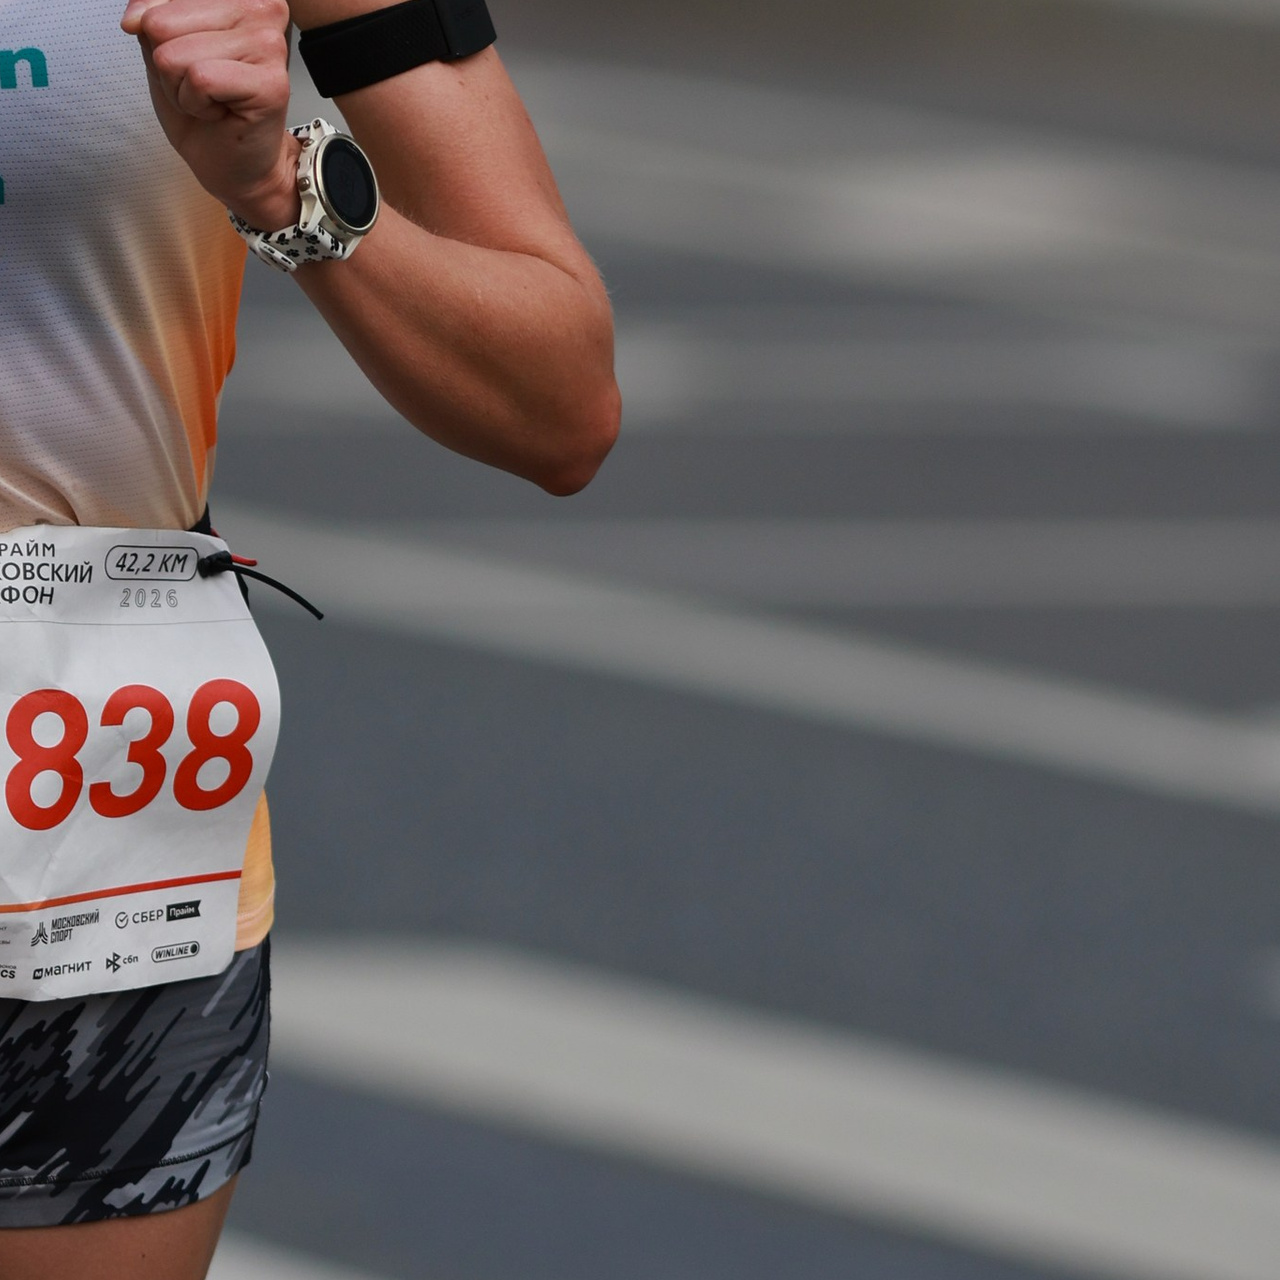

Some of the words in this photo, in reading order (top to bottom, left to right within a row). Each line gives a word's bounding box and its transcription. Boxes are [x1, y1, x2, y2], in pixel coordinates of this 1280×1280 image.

[115, 552, 156, 575] 42,2
[119, 587, 179, 608] 2026
[51, 908, 100, 930] МОСКОВСКИЙ
[131, 908, 164, 924] СБЕР
[169, 905, 195, 918] Прайм
[50, 928, 73, 944] СПОРТ
[122, 954, 139, 964] сбп
[155, 945, 190, 960] WINLINE
